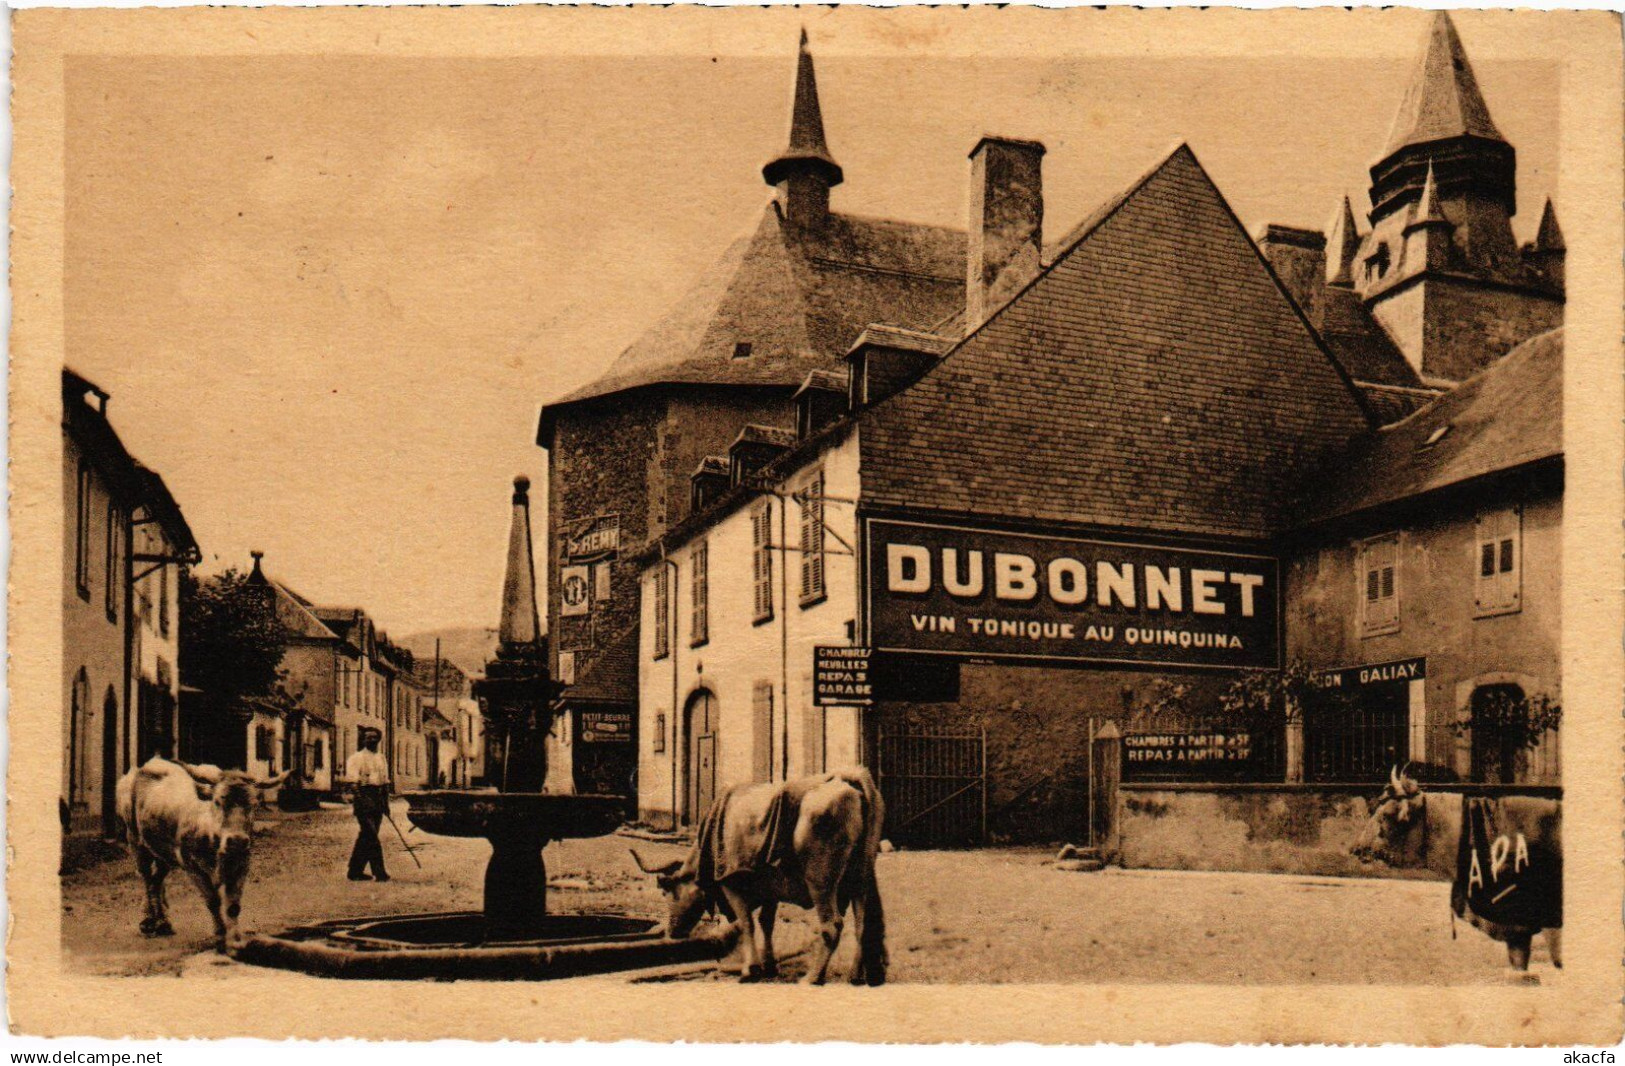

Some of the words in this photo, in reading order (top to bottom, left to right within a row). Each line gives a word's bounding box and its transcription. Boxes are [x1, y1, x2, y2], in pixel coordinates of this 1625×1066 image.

[887, 543, 1263, 616] DUBONNET
[911, 614, 956, 633] VIN
[967, 618, 1074, 640] TONIQUE
[1084, 625, 1114, 642] AU
[1125, 627, 1243, 649] QUINQUINA
[819, 648, 872, 657] CHAMBRES
[819, 672, 866, 682] REPAS
[1360, 663, 1418, 684] GALIAY
[819, 684, 872, 694] GARAGE
[1125, 735, 1175, 747] CHAMBRES
[1188, 734, 1225, 746] PARTIR
[1128, 750, 1173, 761] REPAS
[1188, 748, 1225, 761] PARTIR
